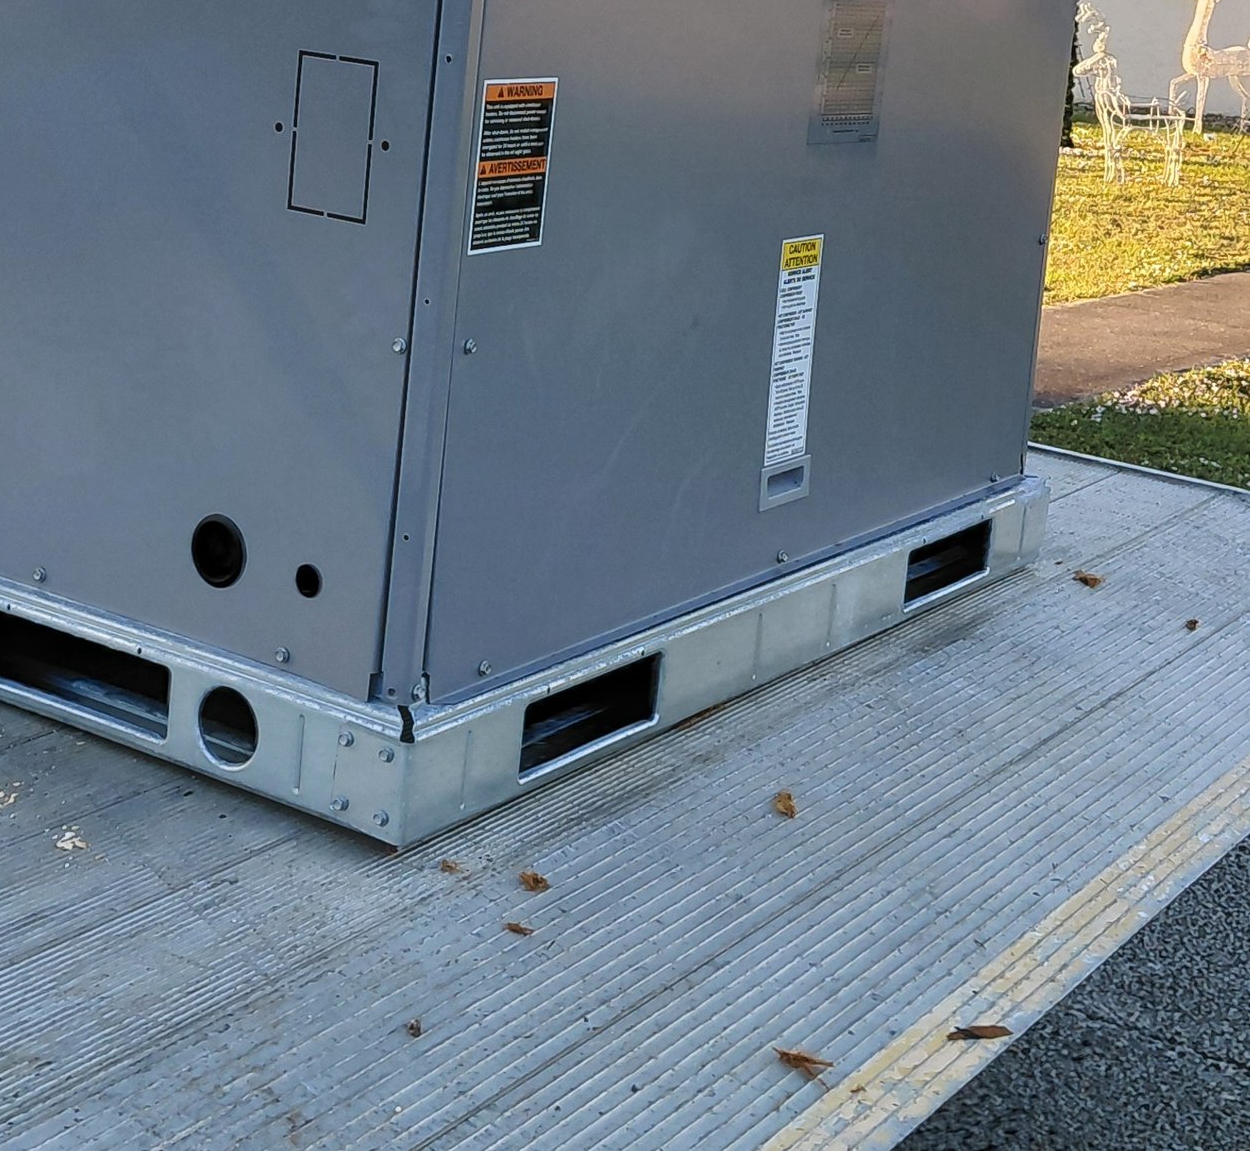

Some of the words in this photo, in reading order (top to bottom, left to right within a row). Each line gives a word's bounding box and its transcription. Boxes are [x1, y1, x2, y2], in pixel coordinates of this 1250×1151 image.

[506, 85, 543, 98] WARNING
[488, 158, 546, 175] AVERTISSEMENT
[788, 241, 817, 255] CAUTION
[784, 254, 818, 268] ATTENTION
